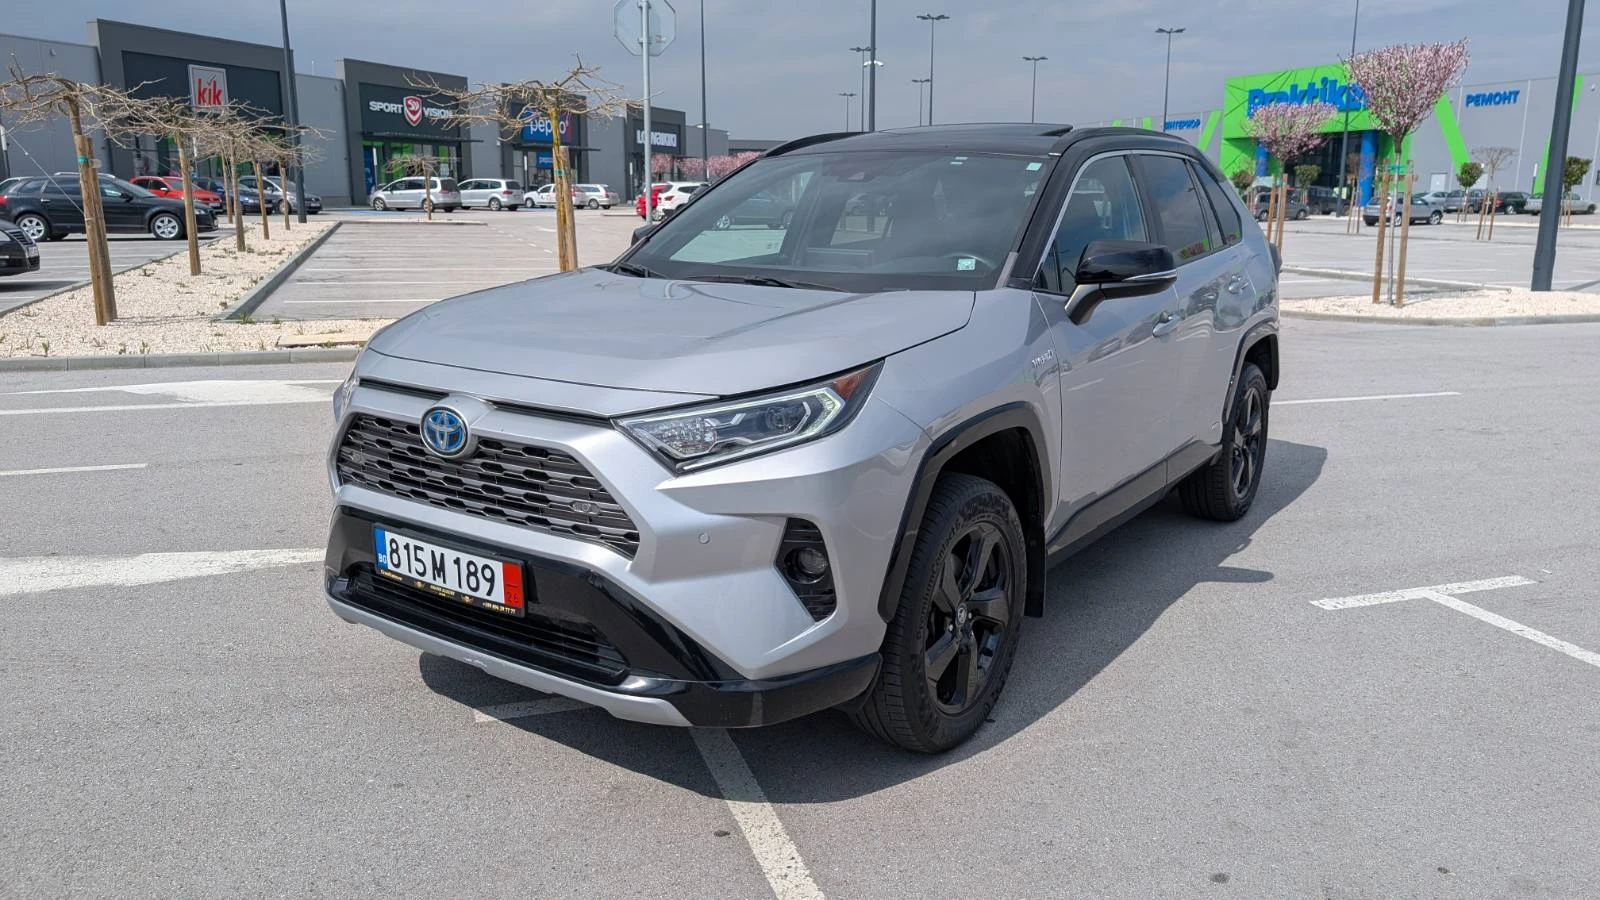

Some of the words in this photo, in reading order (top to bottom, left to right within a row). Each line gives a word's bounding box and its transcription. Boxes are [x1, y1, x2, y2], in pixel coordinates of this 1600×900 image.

[197, 77, 222, 106] kik
[1465, 90, 1521, 107] РЕМОНТ
[369, 101, 403, 114] SPORT
[422, 107, 453, 119] VISION
[530, 119, 567, 137] pepo
